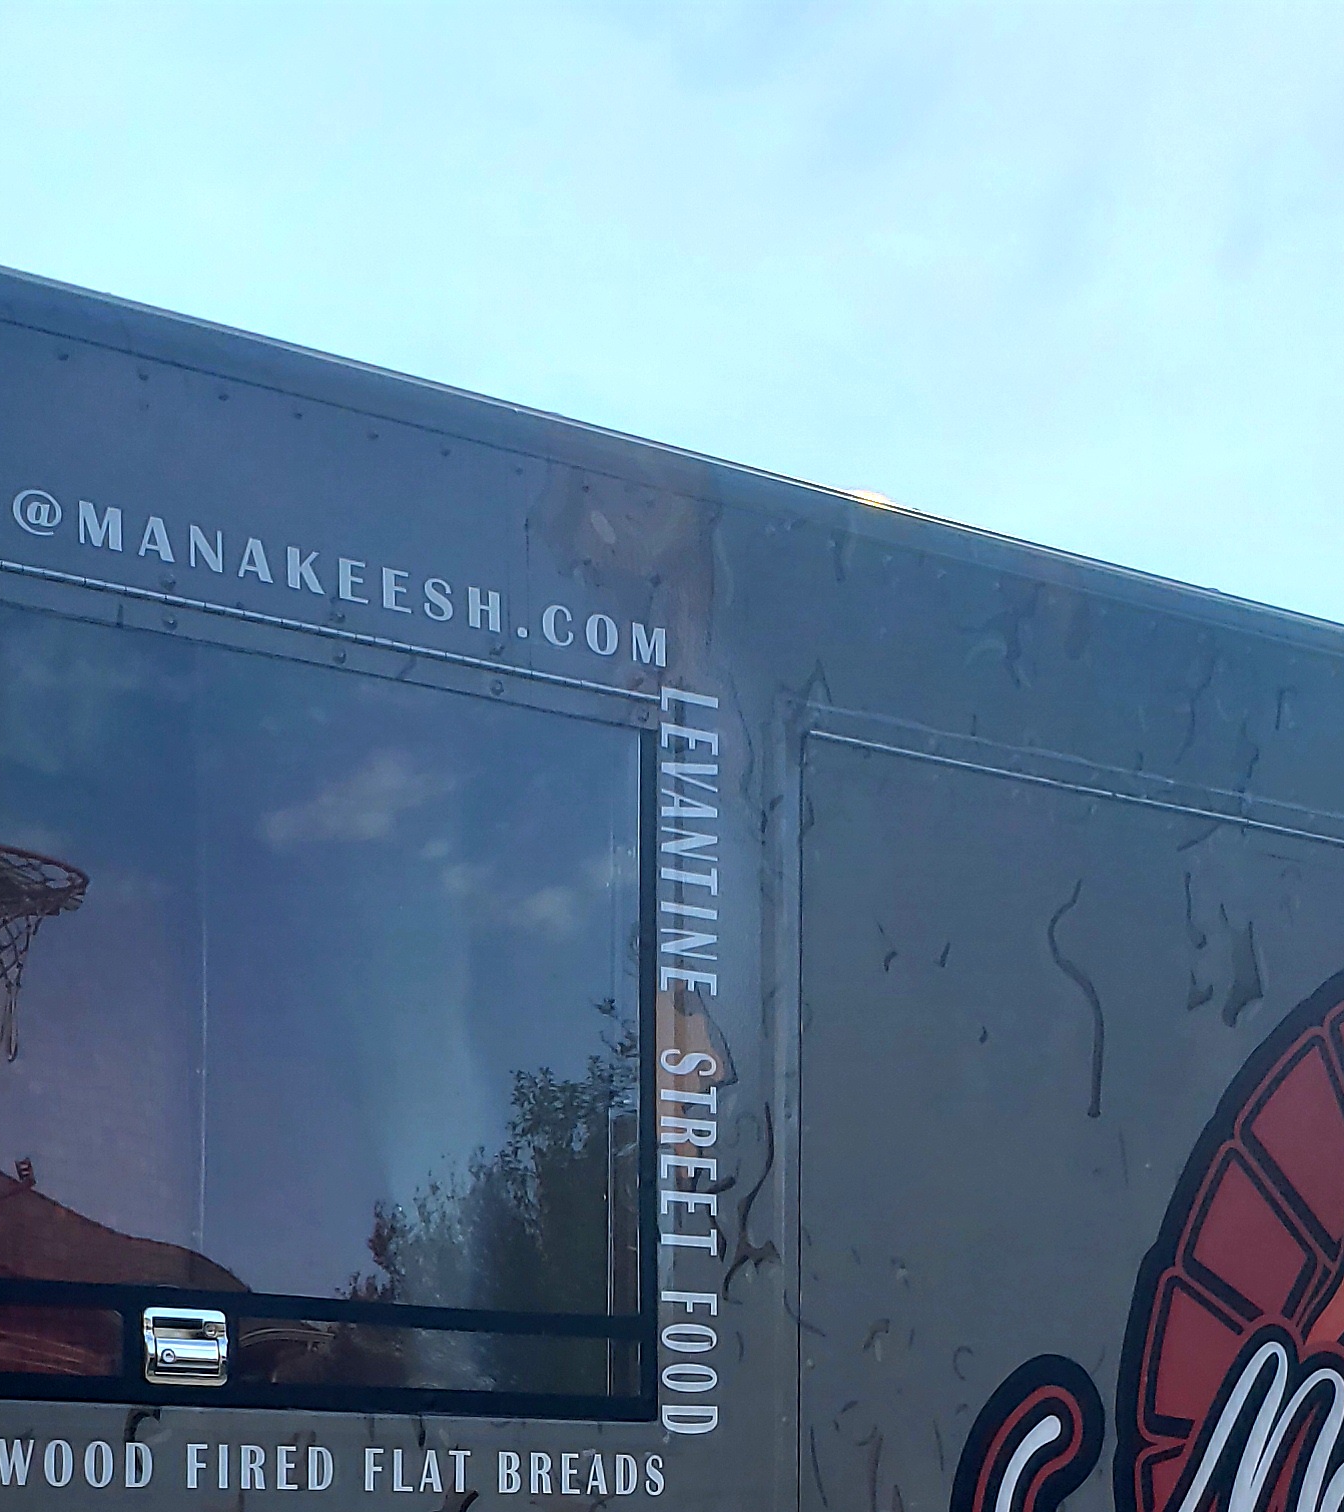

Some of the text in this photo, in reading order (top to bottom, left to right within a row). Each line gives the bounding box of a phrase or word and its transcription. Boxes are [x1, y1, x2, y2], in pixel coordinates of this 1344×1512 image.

[659, 685, 719, 1435] LEVANTINE STREET FOOD
[186, 1442, 335, 1493] FIRED
[363, 1446, 472, 1494] FLAT
[497, 1451, 667, 1497] BREADS
